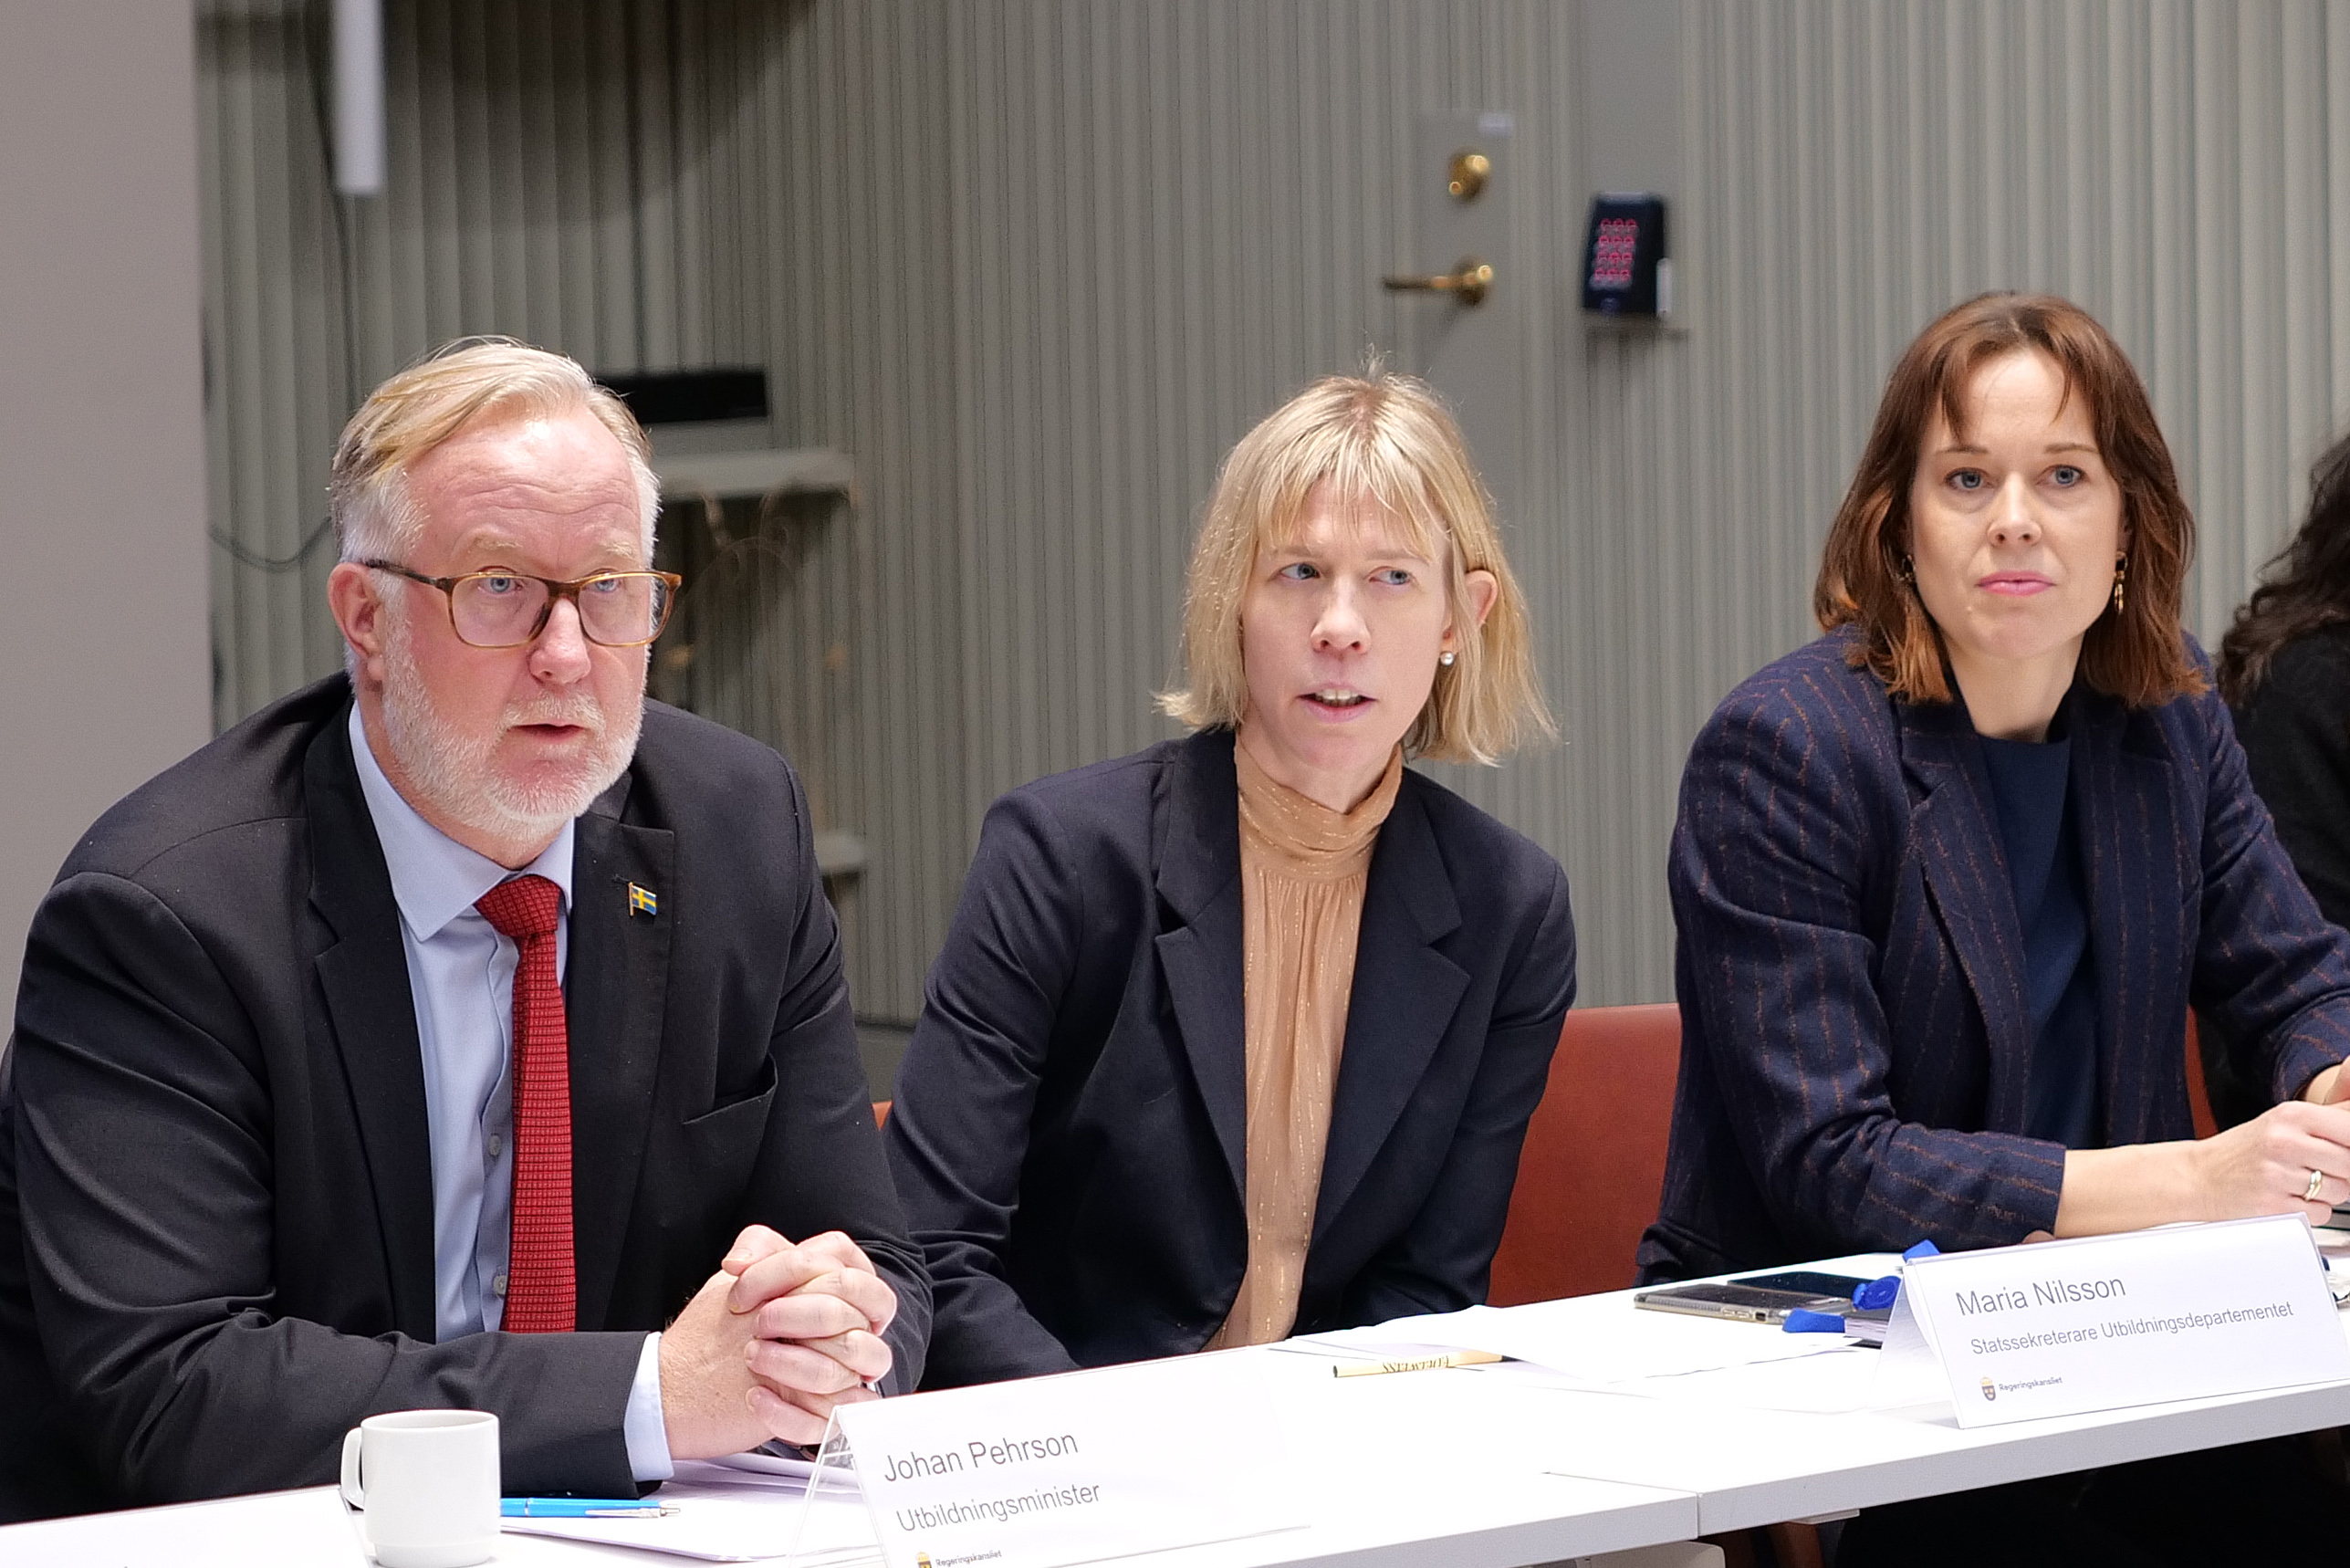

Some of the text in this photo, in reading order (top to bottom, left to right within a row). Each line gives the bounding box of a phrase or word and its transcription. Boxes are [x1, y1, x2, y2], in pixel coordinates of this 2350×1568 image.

[1956, 1275, 2126, 1316] Maria Nilsson
[1970, 1301, 2294, 1355] Statssekreterare Utbildningsdepartementet
[883, 1434, 1079, 1482] Johan Pehrson
[896, 1483, 1101, 1531] Utbildningsminister
